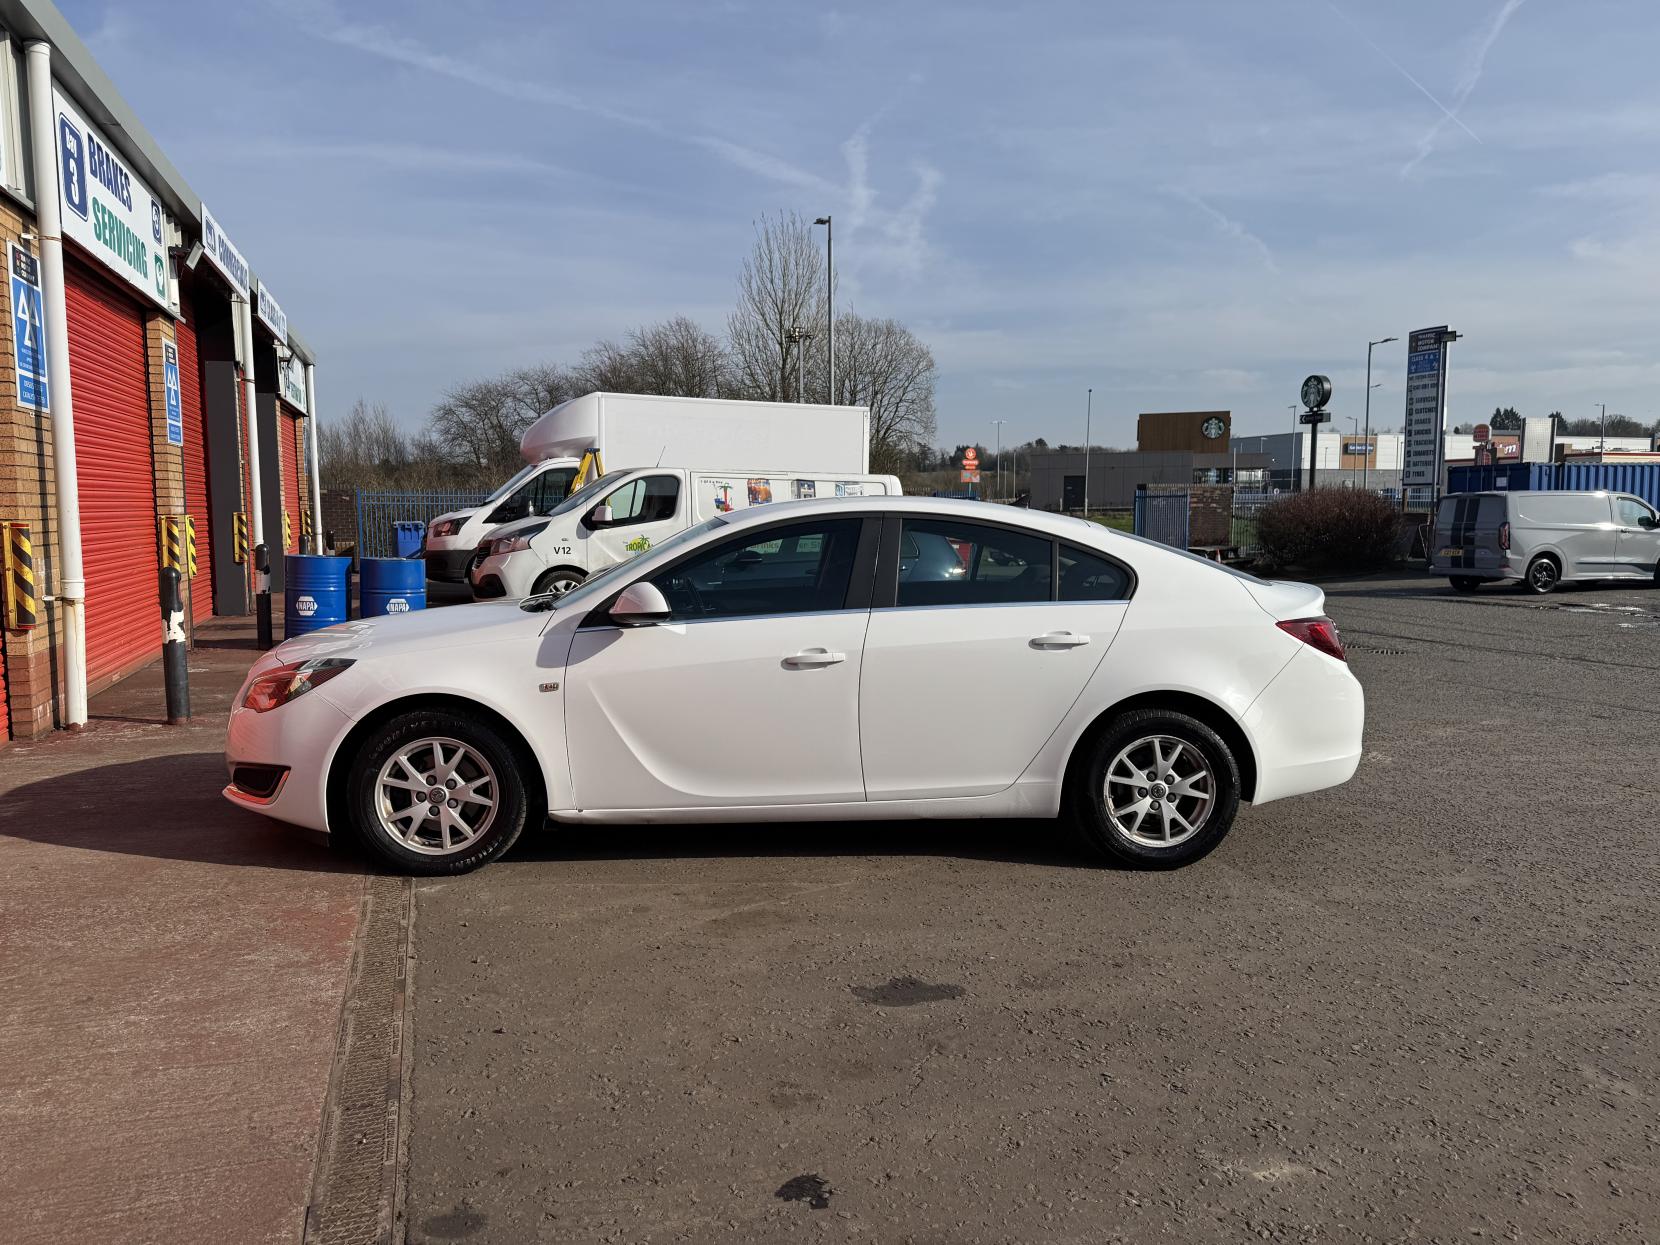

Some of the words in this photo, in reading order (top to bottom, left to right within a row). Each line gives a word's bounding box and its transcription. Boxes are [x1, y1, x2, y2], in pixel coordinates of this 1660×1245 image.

[65, 126, 78, 158] Bay
[69, 158, 80, 206] 3
[87, 131, 133, 213] BRAKES
[91, 196, 149, 281] SERVICING
[553, 547, 560, 555] V
[562, 547, 571, 555] 12
[299, 601, 314, 611] NAPA
[389, 602, 406, 612] NAPA
